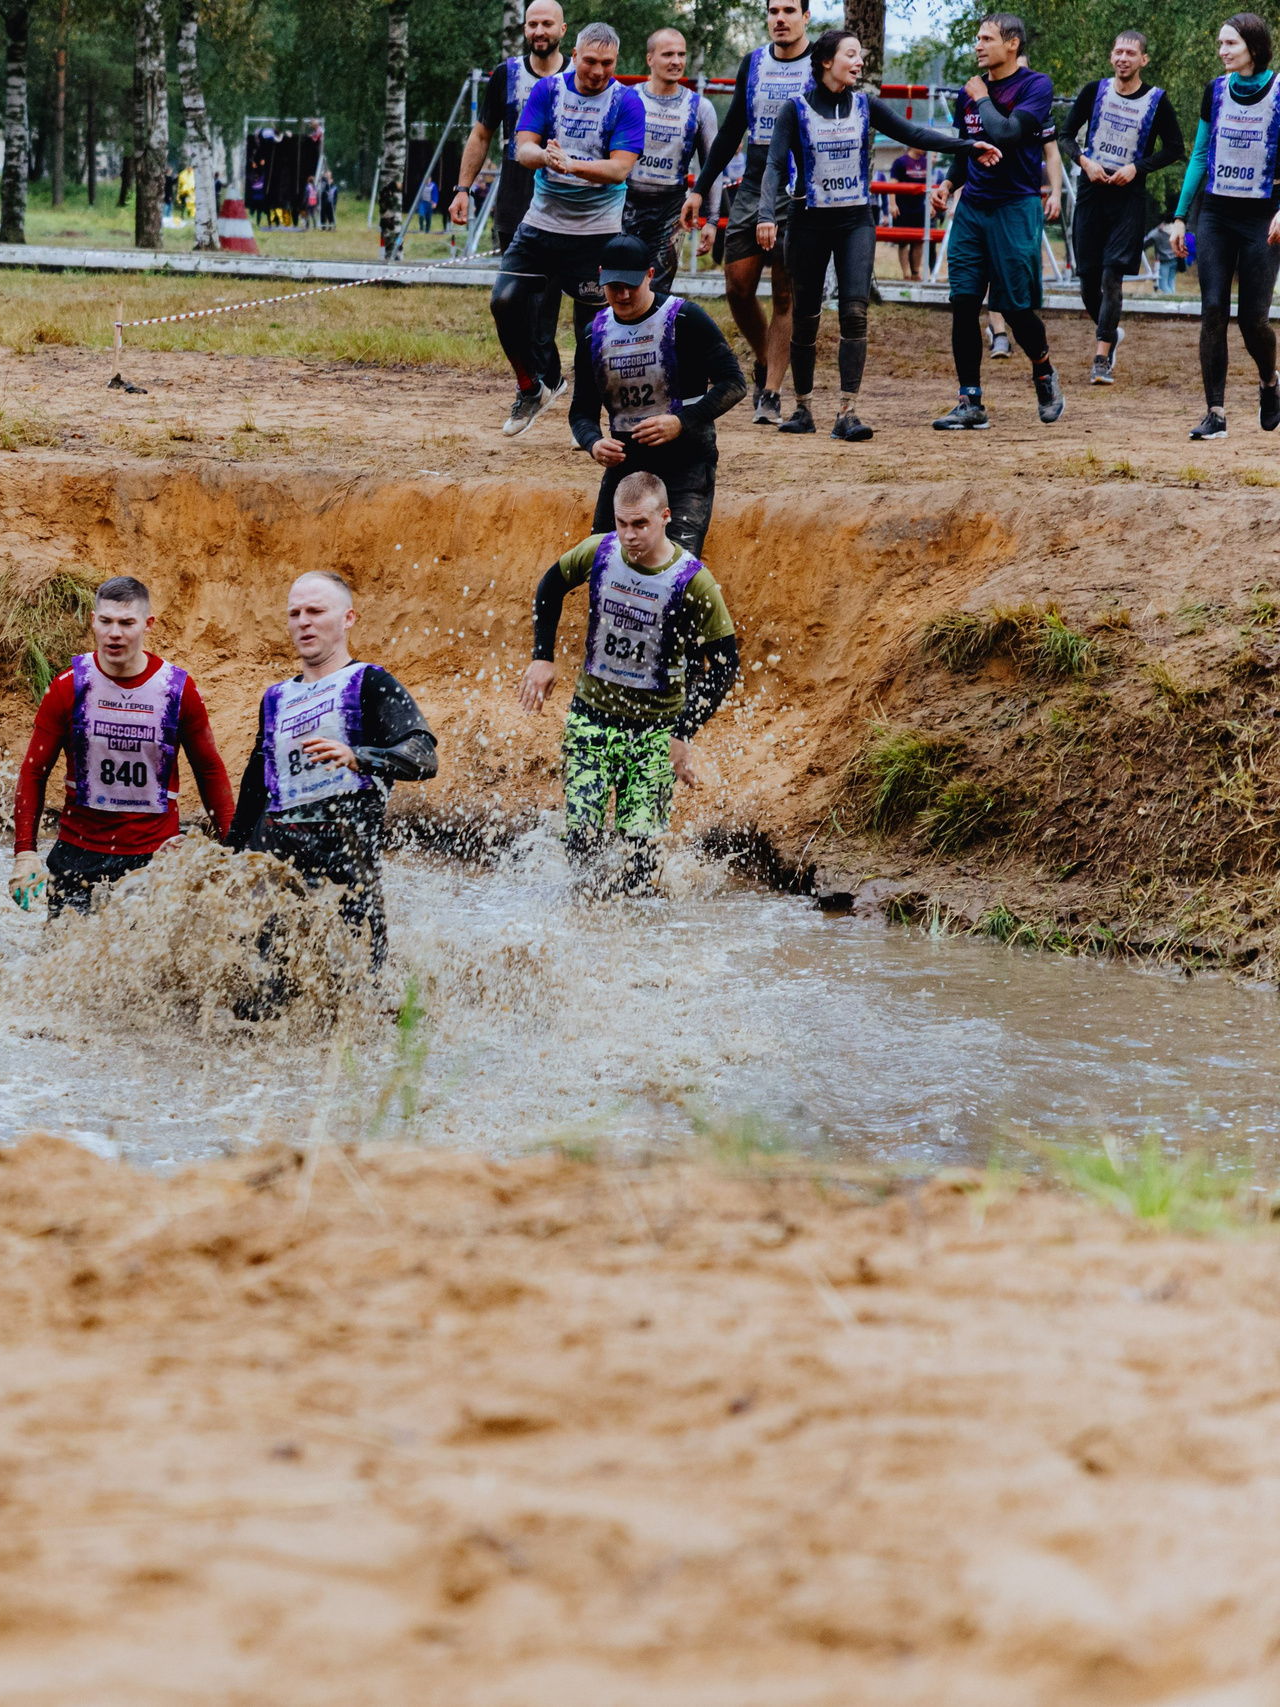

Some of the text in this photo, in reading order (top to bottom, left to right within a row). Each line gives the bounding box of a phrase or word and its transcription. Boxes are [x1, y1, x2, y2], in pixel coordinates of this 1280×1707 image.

[1099, 141, 1128, 158] 20901
[639, 155, 674, 170] 20905
[1217, 164, 1255, 180] 20908
[822, 176, 858, 191] 20904
[611, 334, 654, 345] ГОНКА ГЕРОЕВ
[610, 351, 656, 369] МАССОВЫЙ
[621, 366, 645, 378] СТАРТ
[619, 383, 656, 408] 832
[611, 580, 659, 599] ГОНКА ГЕРОЕВ
[605, 600, 655, 625] МАССОВЫЙ
[615, 616, 642, 631] СТАРТ
[604, 633, 646, 663] 834
[98, 699, 154, 711] ГОНКА ГЕРОЕВ
[281, 699, 334, 733] МАССОВЫЙ
[95, 722, 154, 741] МАССОВЫЙ
[293, 719, 320, 738] СТАРТ
[109, 739, 140, 751] СТАРТ
[100, 758, 147, 788] 840
[110, 798, 151, 806] ГАЗПРОМБАНК
